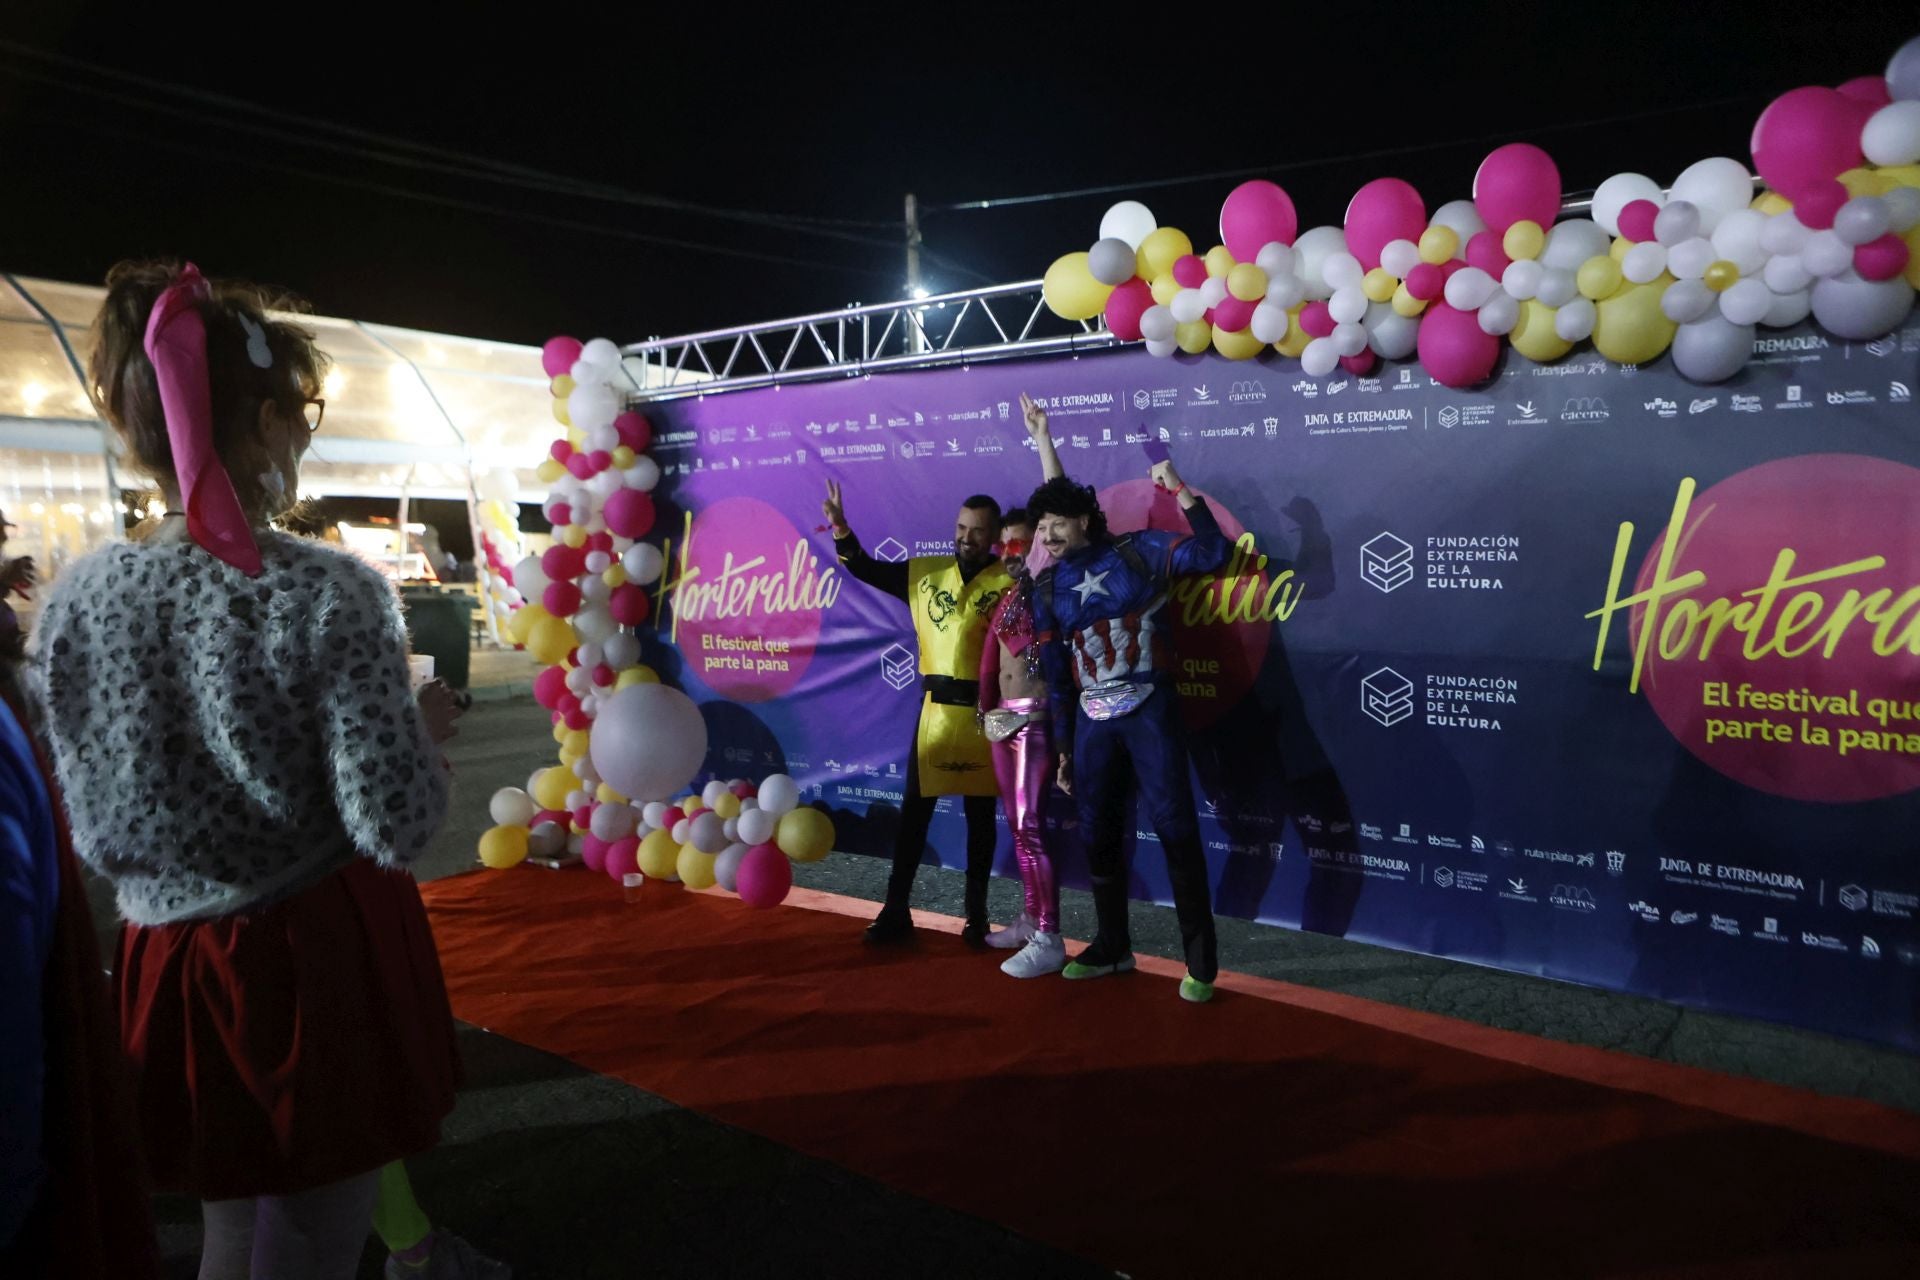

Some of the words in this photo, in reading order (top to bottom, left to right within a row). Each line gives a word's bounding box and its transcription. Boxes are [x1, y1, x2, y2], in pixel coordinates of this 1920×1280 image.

[1754, 334, 1829, 353] TREMADURA
[1062, 393, 1114, 407] EXTREMADURA
[1304, 413, 1329, 427] JUNTA
[1333, 412, 1344, 424] DE
[1347, 409, 1413, 424] EXTREMADURA
[915, 541, 955, 550] FUNDAC
[1427, 534, 1520, 548] FUNDACIÓN
[1427, 548, 1519, 562] EXTREMEÑA
[651, 509, 843, 645] Horteralia
[1427, 564, 1446, 575] DE
[1452, 564, 1472, 575] LA
[1427, 577, 1504, 590] CULTURA
[1583, 475, 1920, 695] Hortera
[702, 633, 714, 650] El
[716, 633, 764, 652] festival
[765, 640, 790, 657] que
[704, 655, 740, 673] parte
[742, 653, 755, 670] la
[756, 658, 790, 675] pana
[1182, 657, 1221, 679] que
[1426, 674, 1518, 691] FUNDACIÓN
[1426, 688, 1517, 705] EXTREMEÑA
[1701, 681, 1731, 708] El
[1736, 682, 1861, 718] festival
[1426, 701, 1445, 713] DE
[1451, 703, 1471, 715] LA
[1426, 714, 1502, 731] CULTURA
[1705, 716, 1794, 744] parte
[1800, 717, 1831, 746] la
[837, 785, 853, 796] JUNTA
[855, 787, 862, 797] DE
[864, 789, 904, 801] EXTREMADURA
[1308, 847, 1332, 861] JUNTA
[1335, 851, 1345, 863] DE
[1348, 853, 1411, 873] EXTREMADURA
[1659, 856, 1693, 875] JUNTA
[1697, 862, 1712, 877] DE
[1716, 864, 1805, 891] EXTREMADURA
